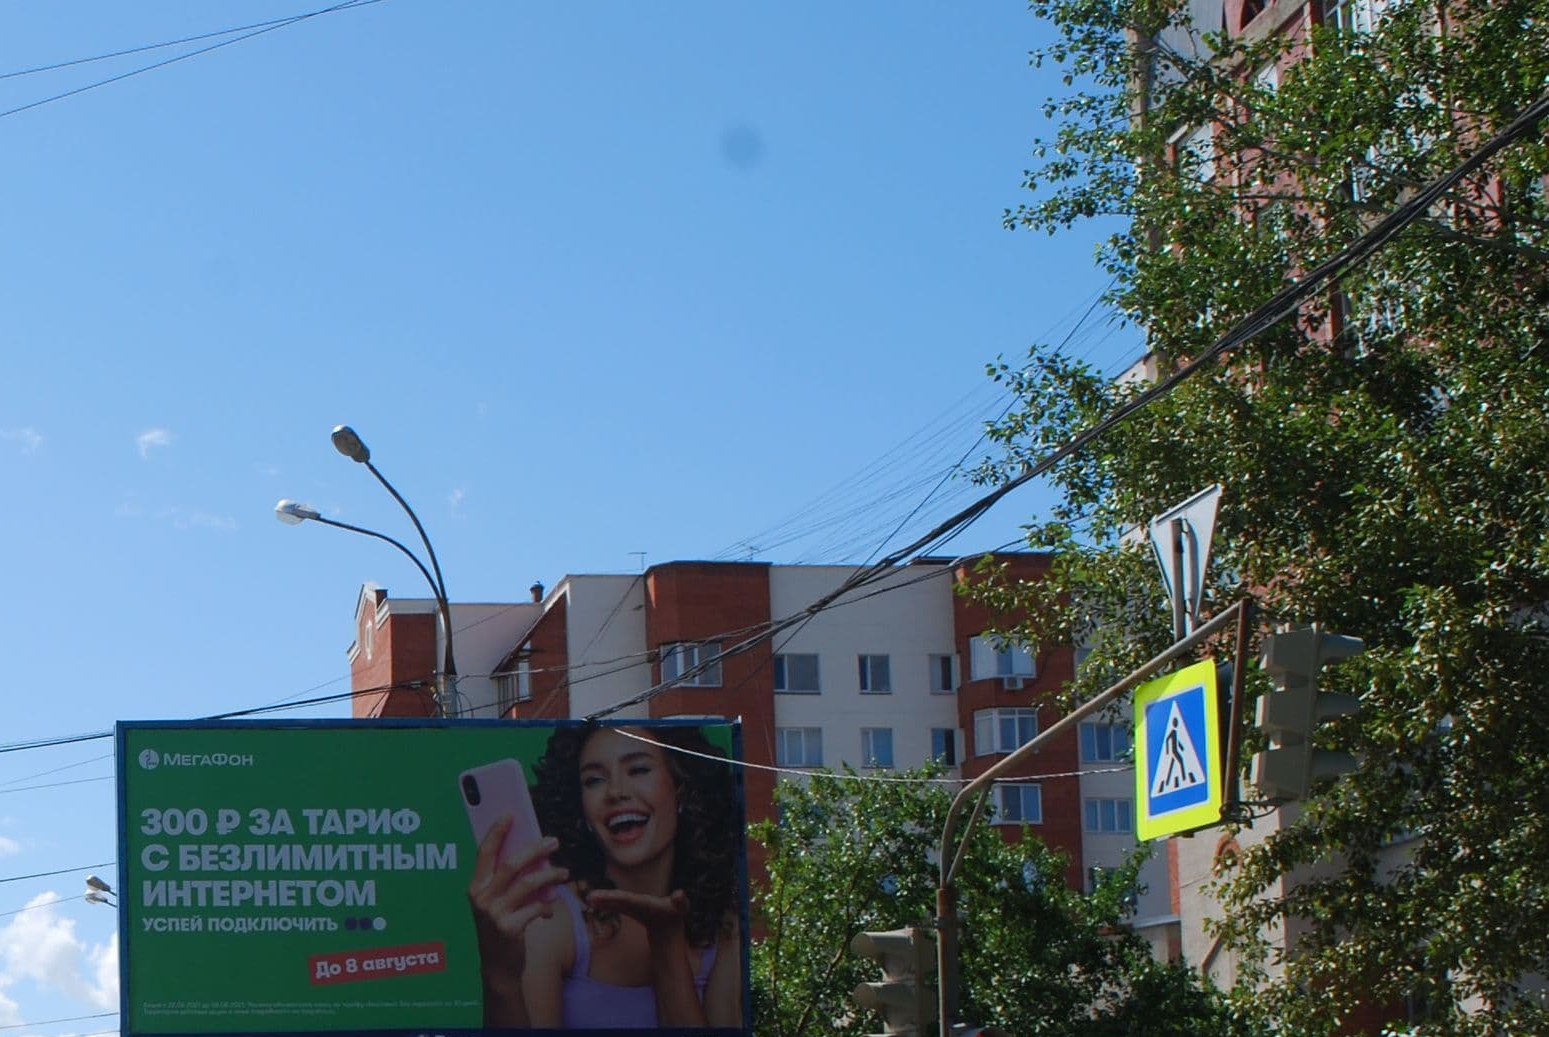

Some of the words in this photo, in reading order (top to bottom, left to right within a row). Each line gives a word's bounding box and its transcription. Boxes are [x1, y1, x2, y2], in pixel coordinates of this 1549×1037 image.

[141, 808, 208, 836] 300
[249, 808, 295, 836] ЗА
[302, 808, 421, 835] ТАРИФ
[141, 844, 170, 871] С
[179, 843, 457, 871] БЕЗЛИМИТНЫМ
[142, 880, 376, 907] ИНТЕРНЕТОМ
[142, 916, 202, 931] УСПЕЙ
[208, 916, 338, 933] ПОДКЛЮЧИТЬ
[315, 961, 341, 979] До
[346, 958, 357, 973] 8
[362, 952, 439, 971] августа
